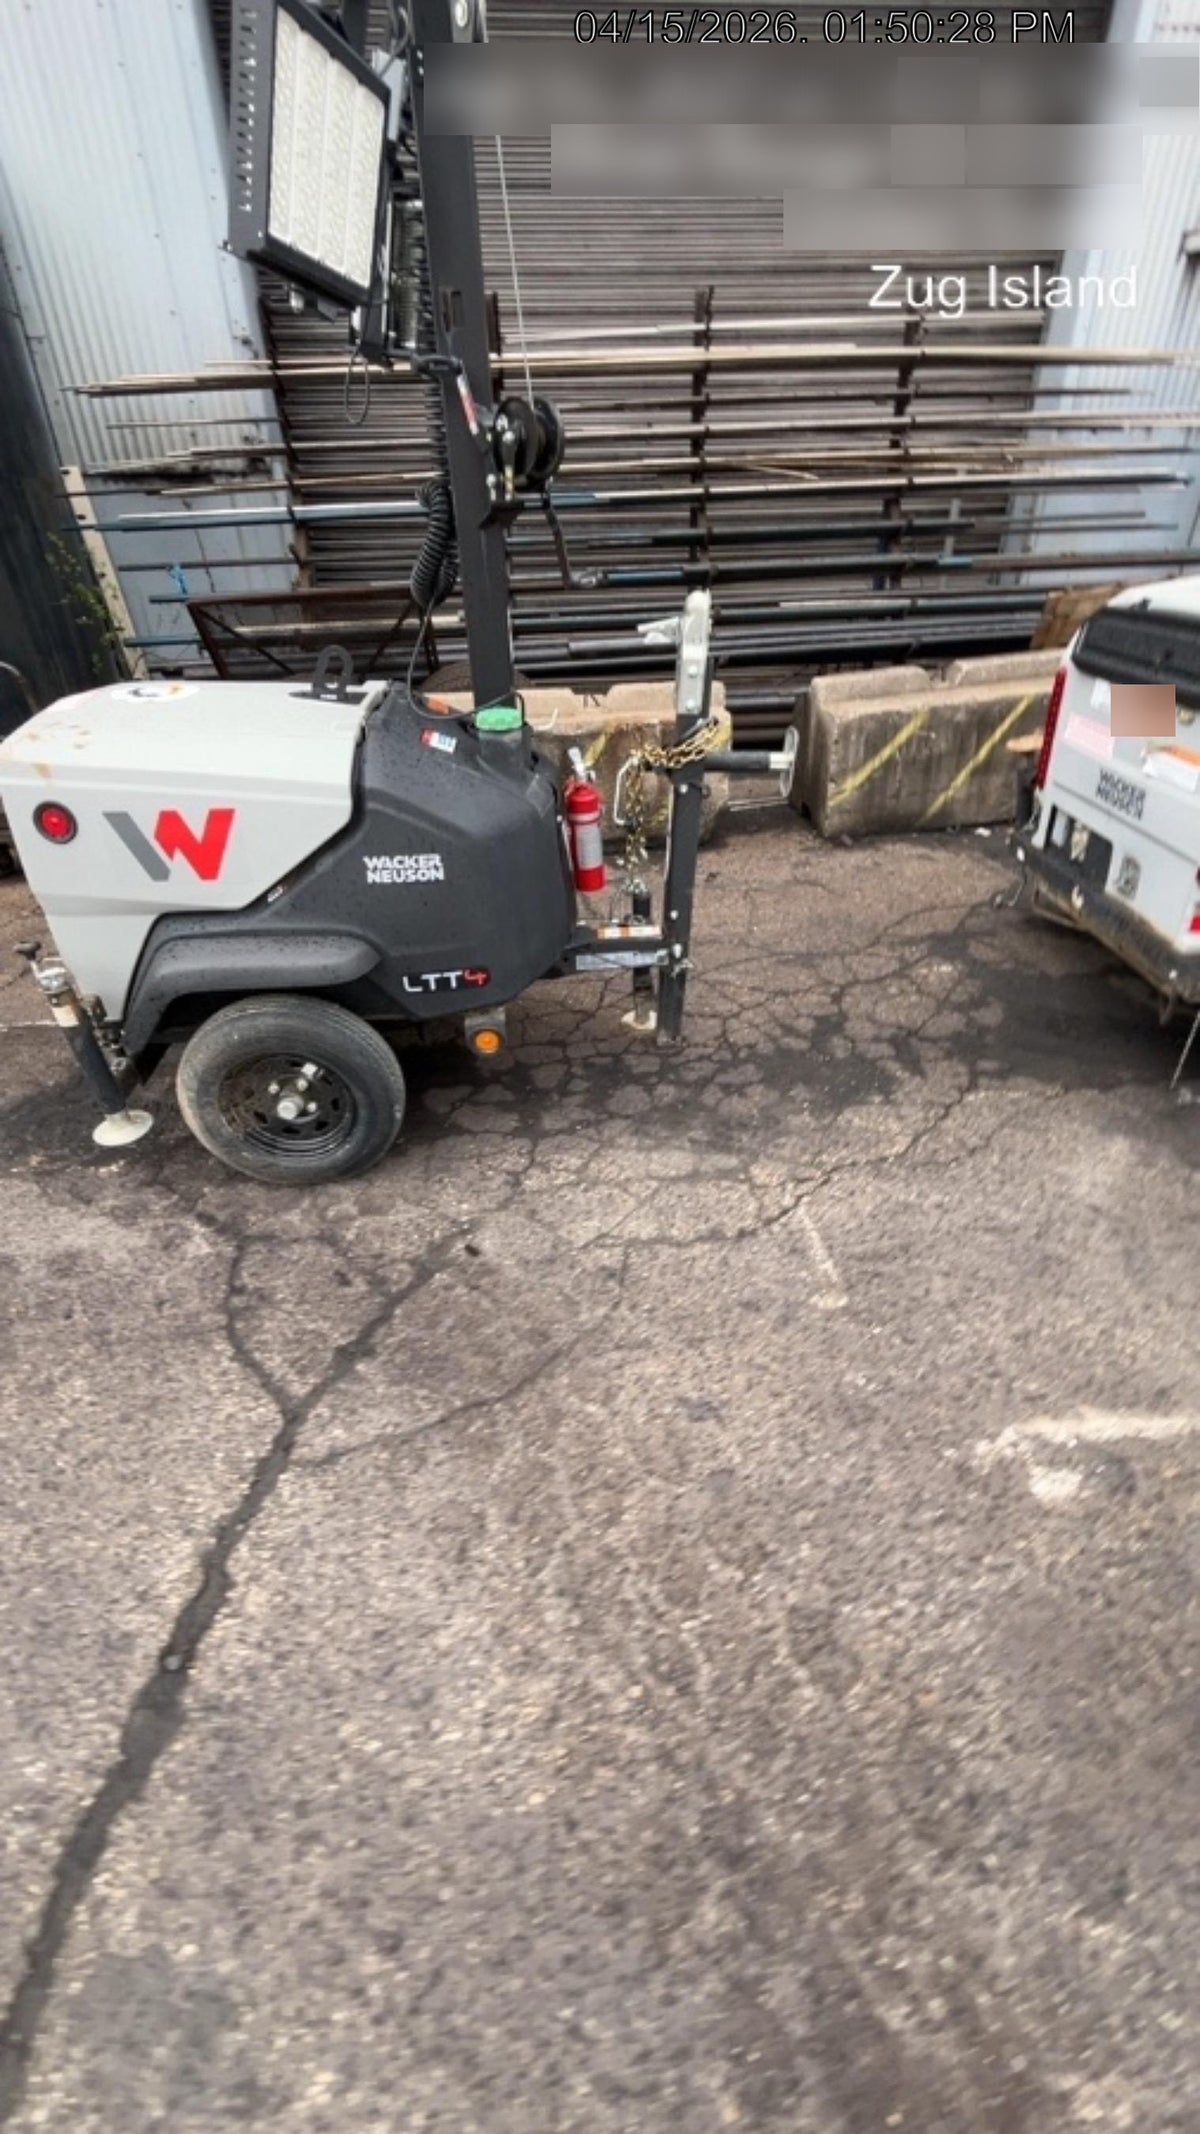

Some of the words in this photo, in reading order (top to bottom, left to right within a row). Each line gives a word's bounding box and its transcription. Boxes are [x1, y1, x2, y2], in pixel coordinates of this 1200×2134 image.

[362, 853, 442, 869] WACKER
[367, 867, 444, 884] NEUSON
[402, 968, 488, 992] LTT4
